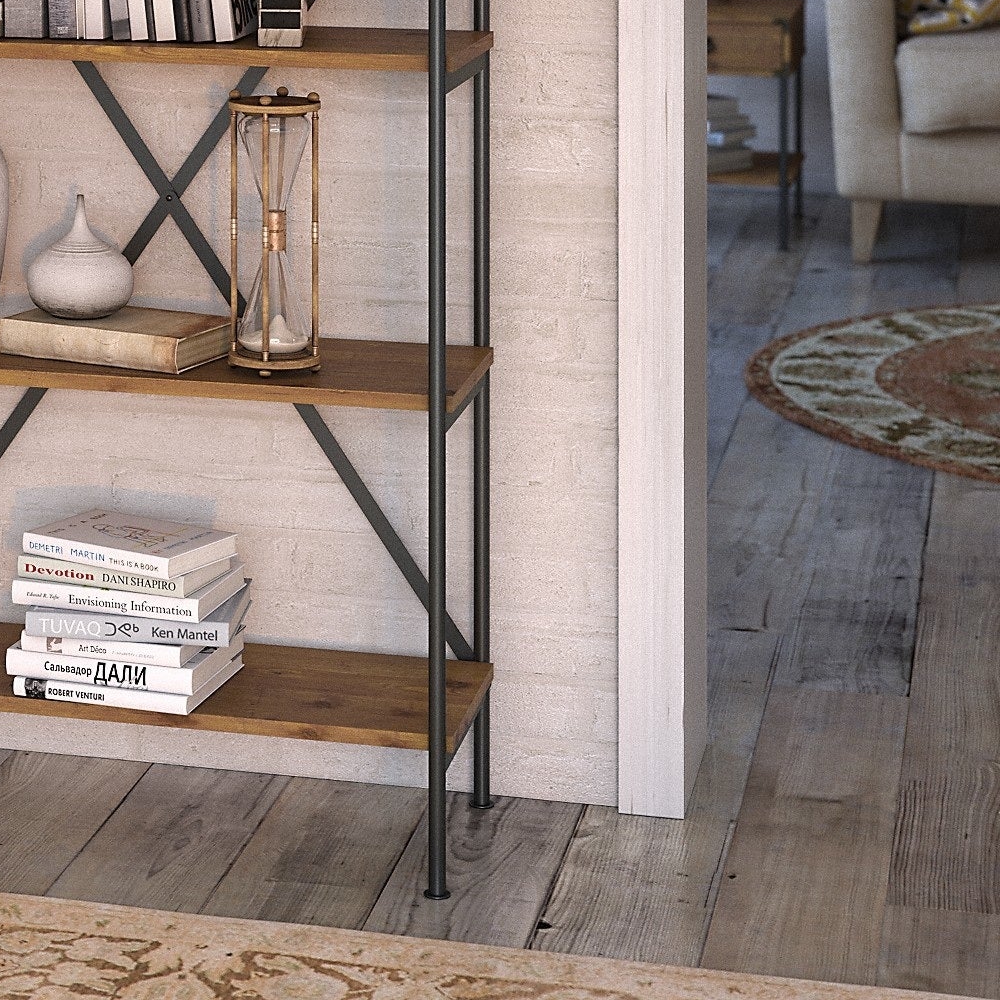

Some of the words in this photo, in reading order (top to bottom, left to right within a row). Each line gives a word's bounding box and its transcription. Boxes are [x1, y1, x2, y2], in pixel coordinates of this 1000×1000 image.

[29, 541, 63, 555] DEMETRI
[70, 548, 105, 562] MARTIN
[109, 557, 125, 566] THIS
[126, 559, 133, 567] IS
[140, 562, 159, 572] BOOK
[24, 563, 95, 581] Devotion
[102, 573, 129, 585] DANI
[130, 577, 176, 591] SHAPIRO
[68, 594, 128, 613] Envisioning
[131, 600, 192, 617] Information
[39, 618, 101, 637] TUVAQ
[151, 626, 174, 639] Ken
[177, 628, 218, 641] Mantel
[78, 644, 89, 653] Art
[44, 661, 92, 677] Сальвадор
[93, 661, 146, 686] ДАЛИ
[48, 687, 74, 698] ROBERT
[75, 691, 105, 701] VENTURI
